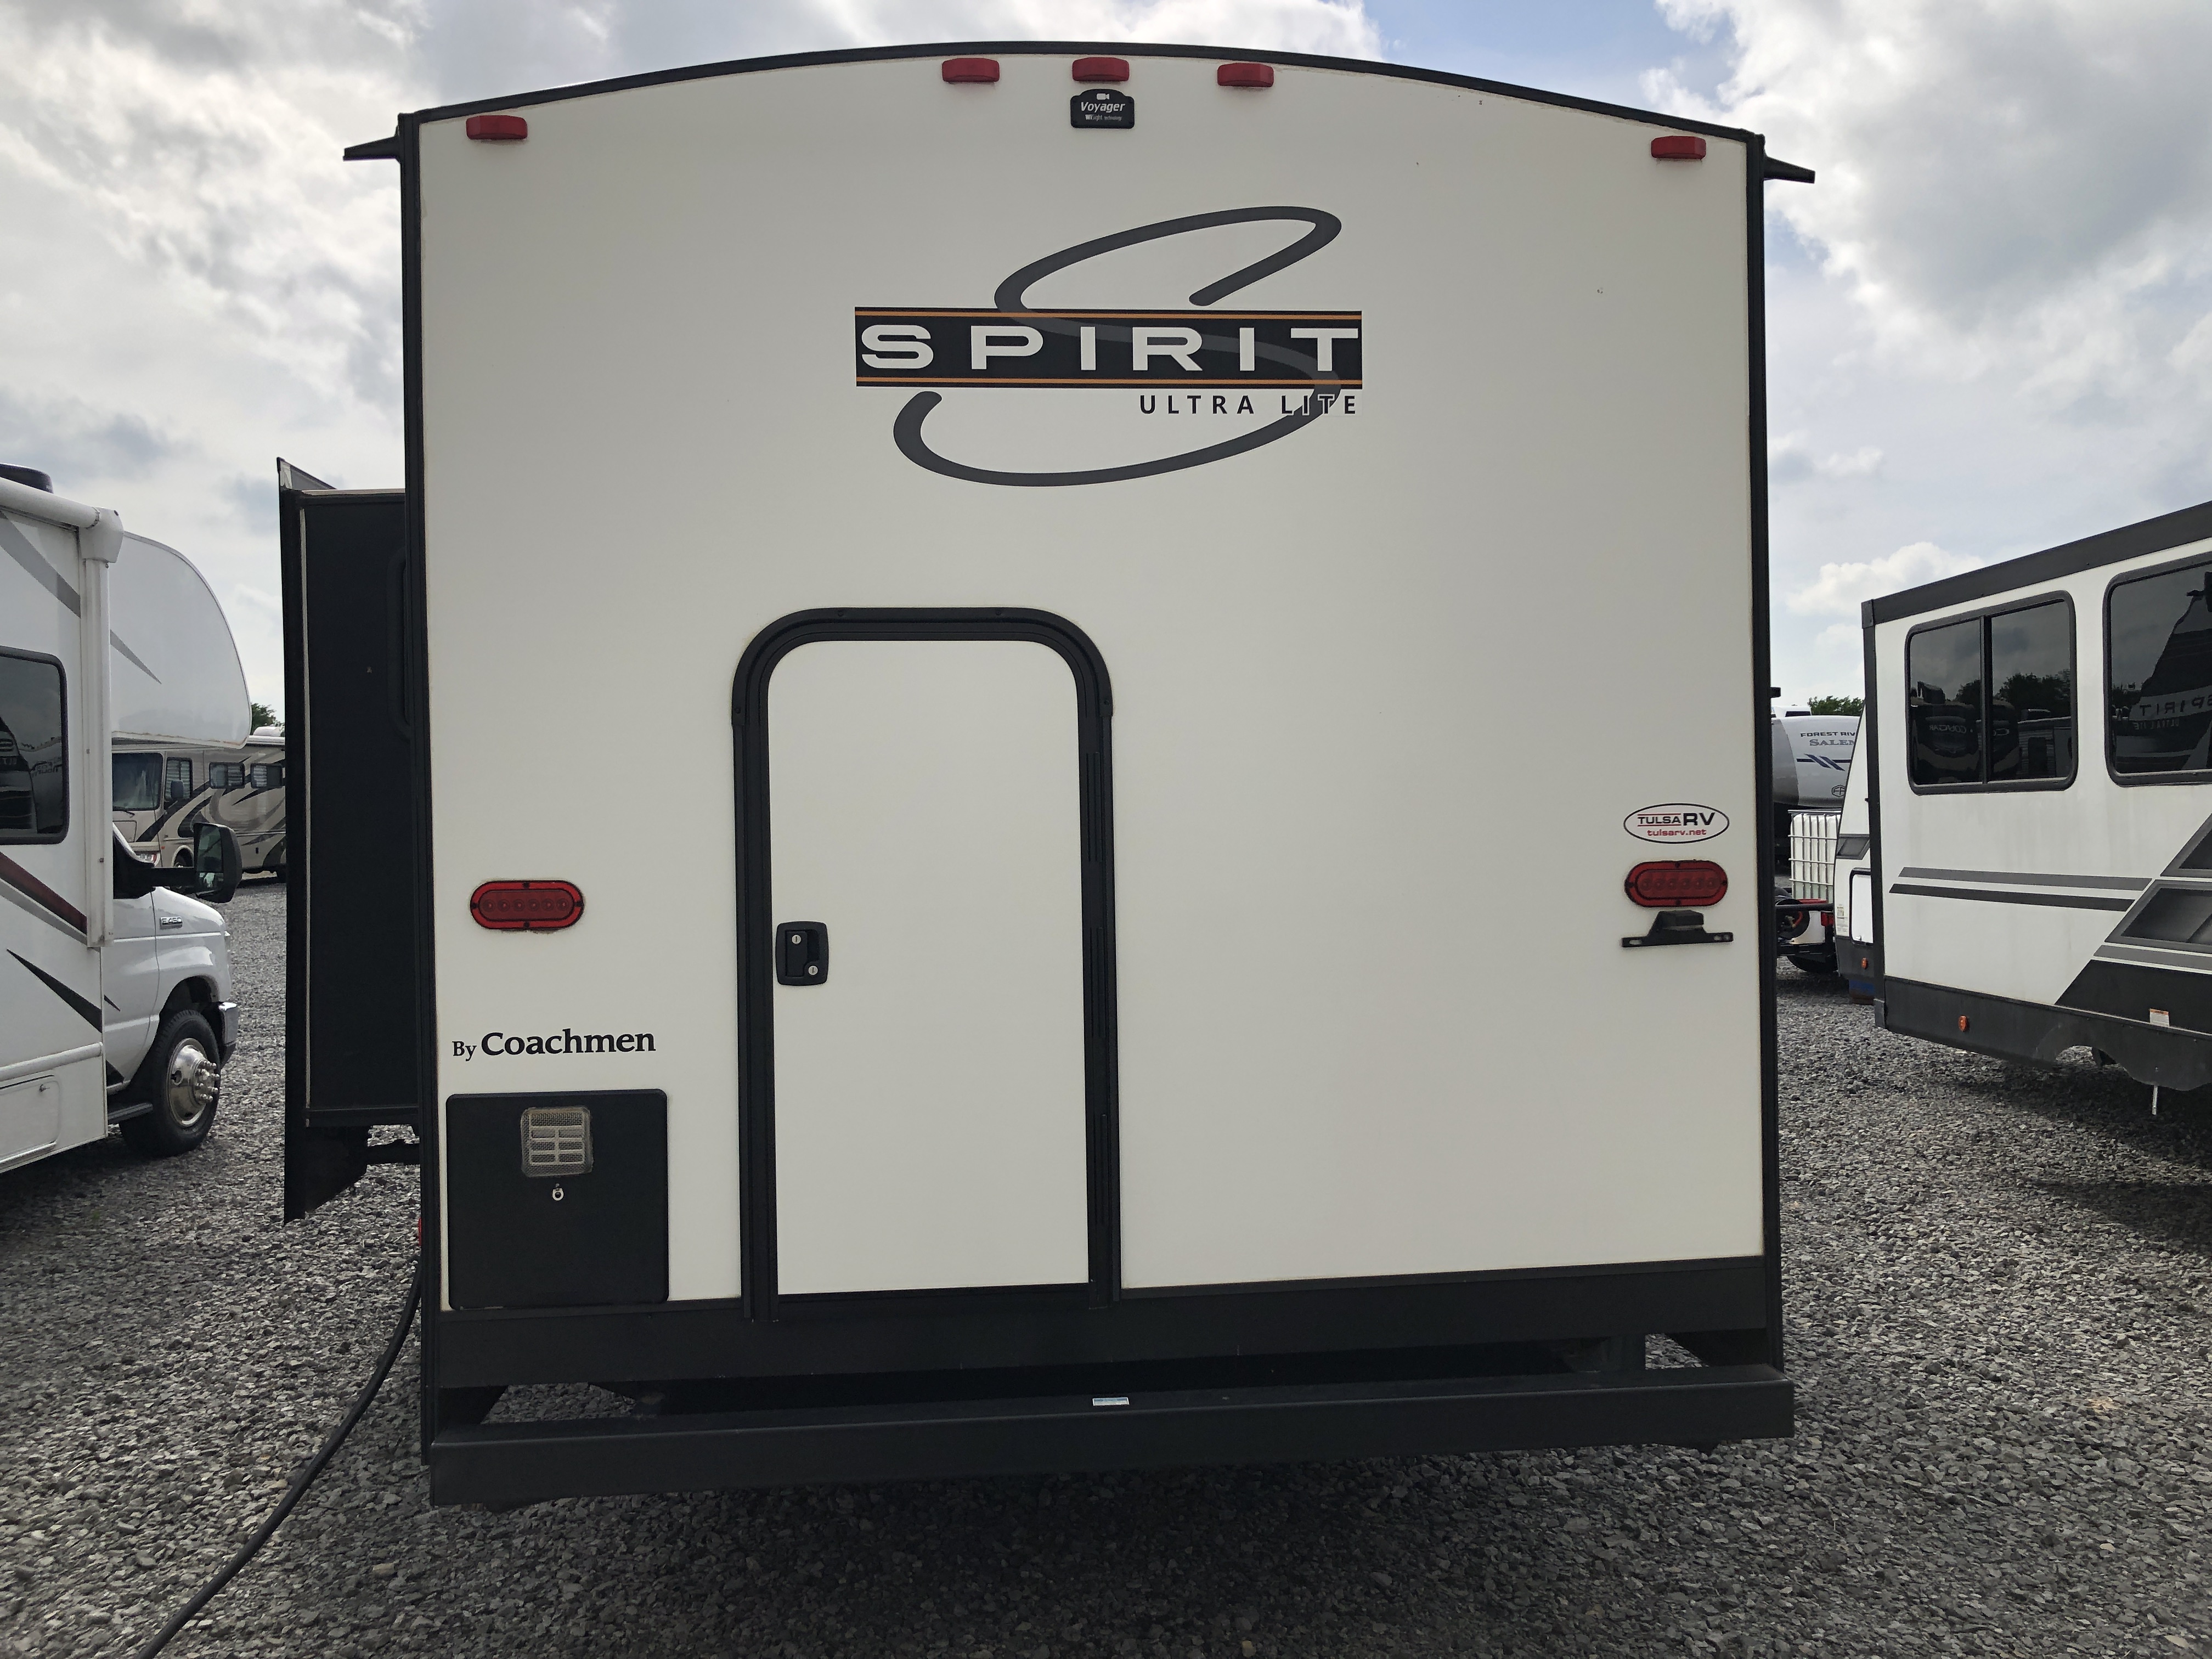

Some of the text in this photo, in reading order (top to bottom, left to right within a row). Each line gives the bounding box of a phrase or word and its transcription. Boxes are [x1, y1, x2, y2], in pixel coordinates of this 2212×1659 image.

[1081, 101, 1126, 113] Voyager
[861, 324, 1359, 373] SPIRIT
[1139, 394, 1356, 415] ULTRA LITE
[1646, 828, 1707, 837] tulsarv.net
[452, 1028, 657, 1062] By Coachmen
